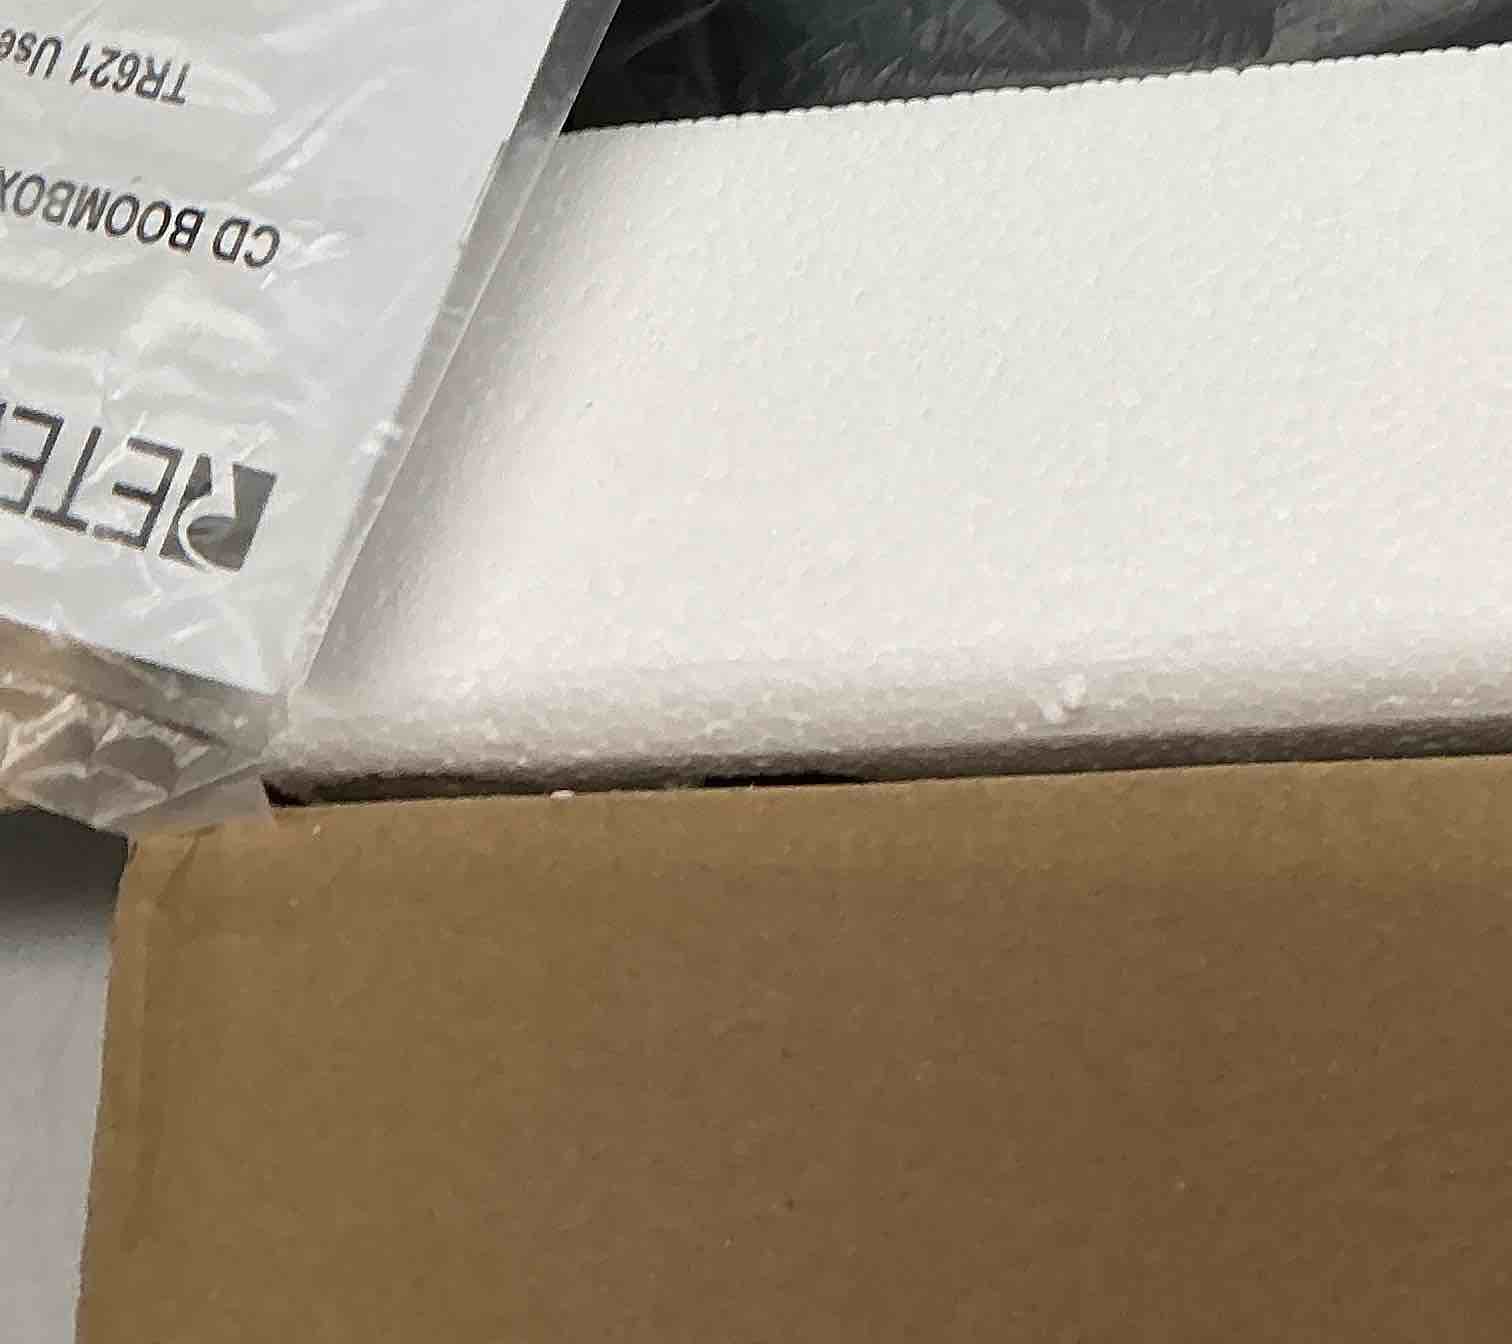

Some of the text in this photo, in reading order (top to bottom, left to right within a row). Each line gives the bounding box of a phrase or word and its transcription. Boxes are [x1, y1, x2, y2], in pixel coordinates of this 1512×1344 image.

[70, 42, 191, 107] TR621
[0, 166, 281, 271] CD BOOMBOX
[0, 402, 279, 574] RETE
